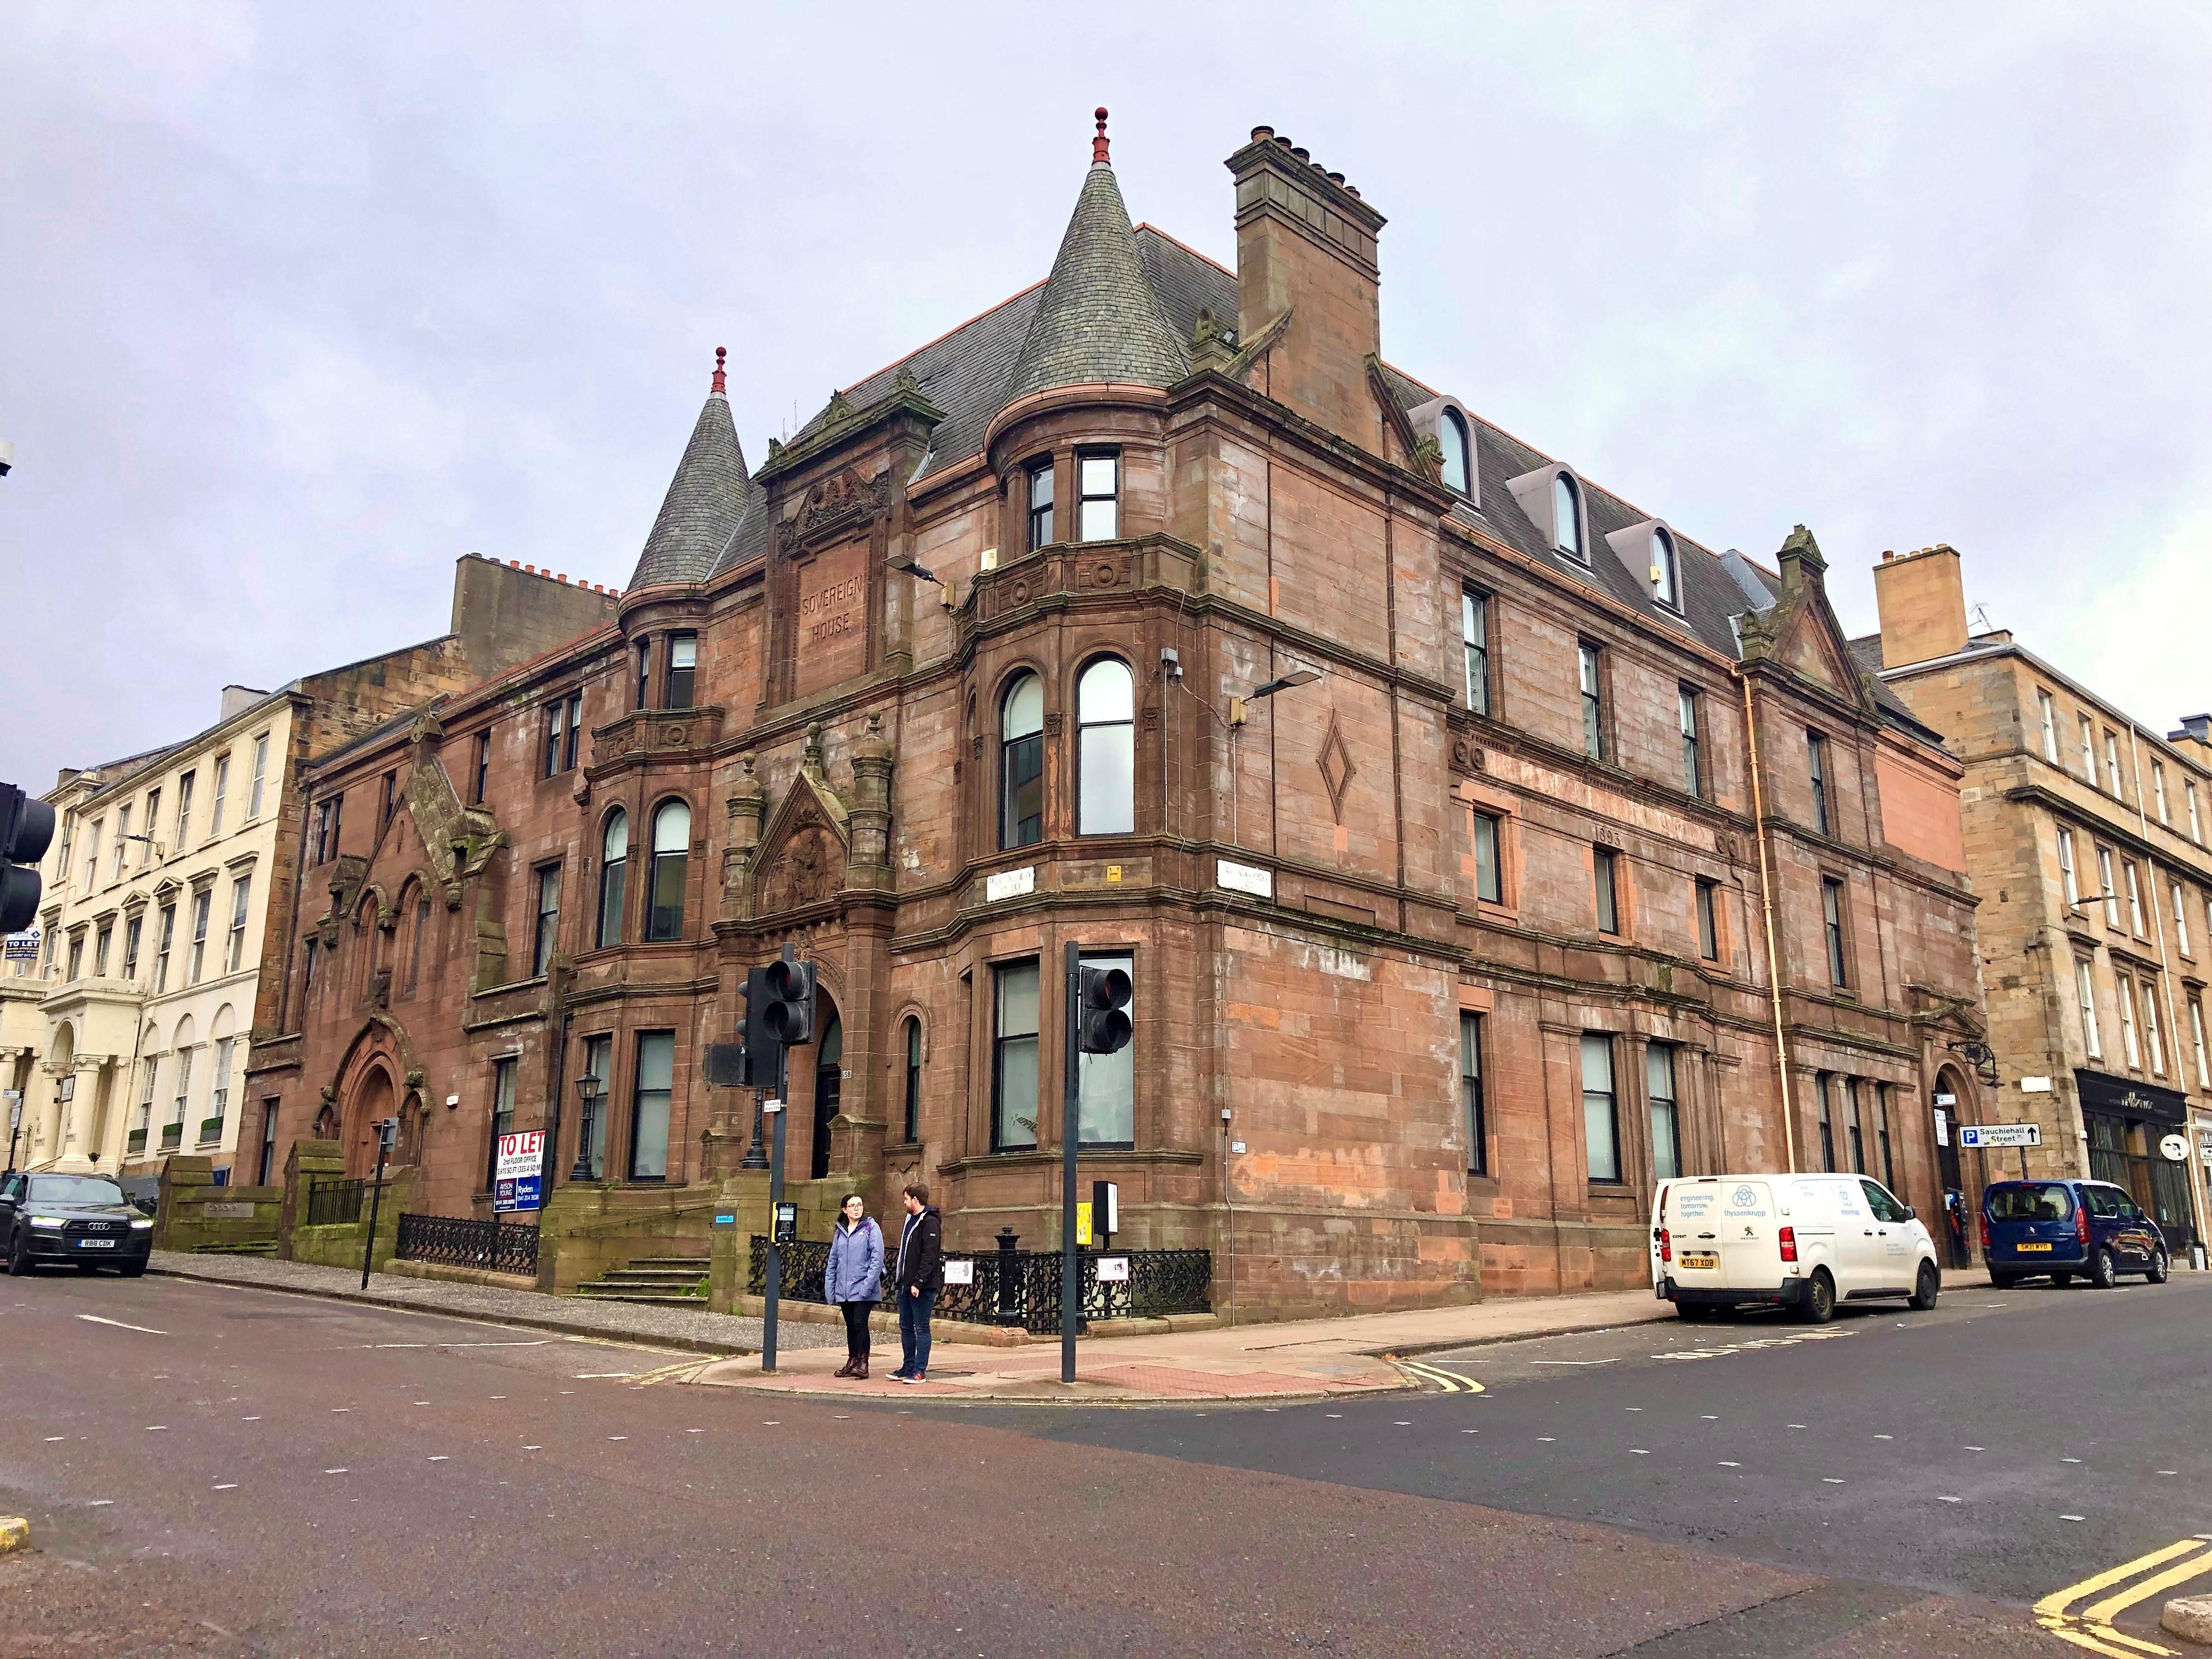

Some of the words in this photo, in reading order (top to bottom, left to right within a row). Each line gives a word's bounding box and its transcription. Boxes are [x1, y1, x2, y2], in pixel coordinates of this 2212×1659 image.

[802, 575, 862, 615] SOVEREIGN
[812, 612, 849, 642] HOUSE
[1595, 826, 1620, 846] 1893
[1008, 871, 1031, 882] RENT
[1000, 883, 1021, 894] STEET
[1979, 1127, 2025, 1135] Sauchiehall
[500, 1135, 517, 1156] TO
[520, 1131, 545, 1154] LET
[510, 1156, 523, 1165] FLOOR
[523, 1155, 537, 1163] OFFICE
[518, 1185, 533, 1195] Ryden
[1680, 1210, 1705, 1218] together.
[1681, 1259, 1699, 1267] MT67
